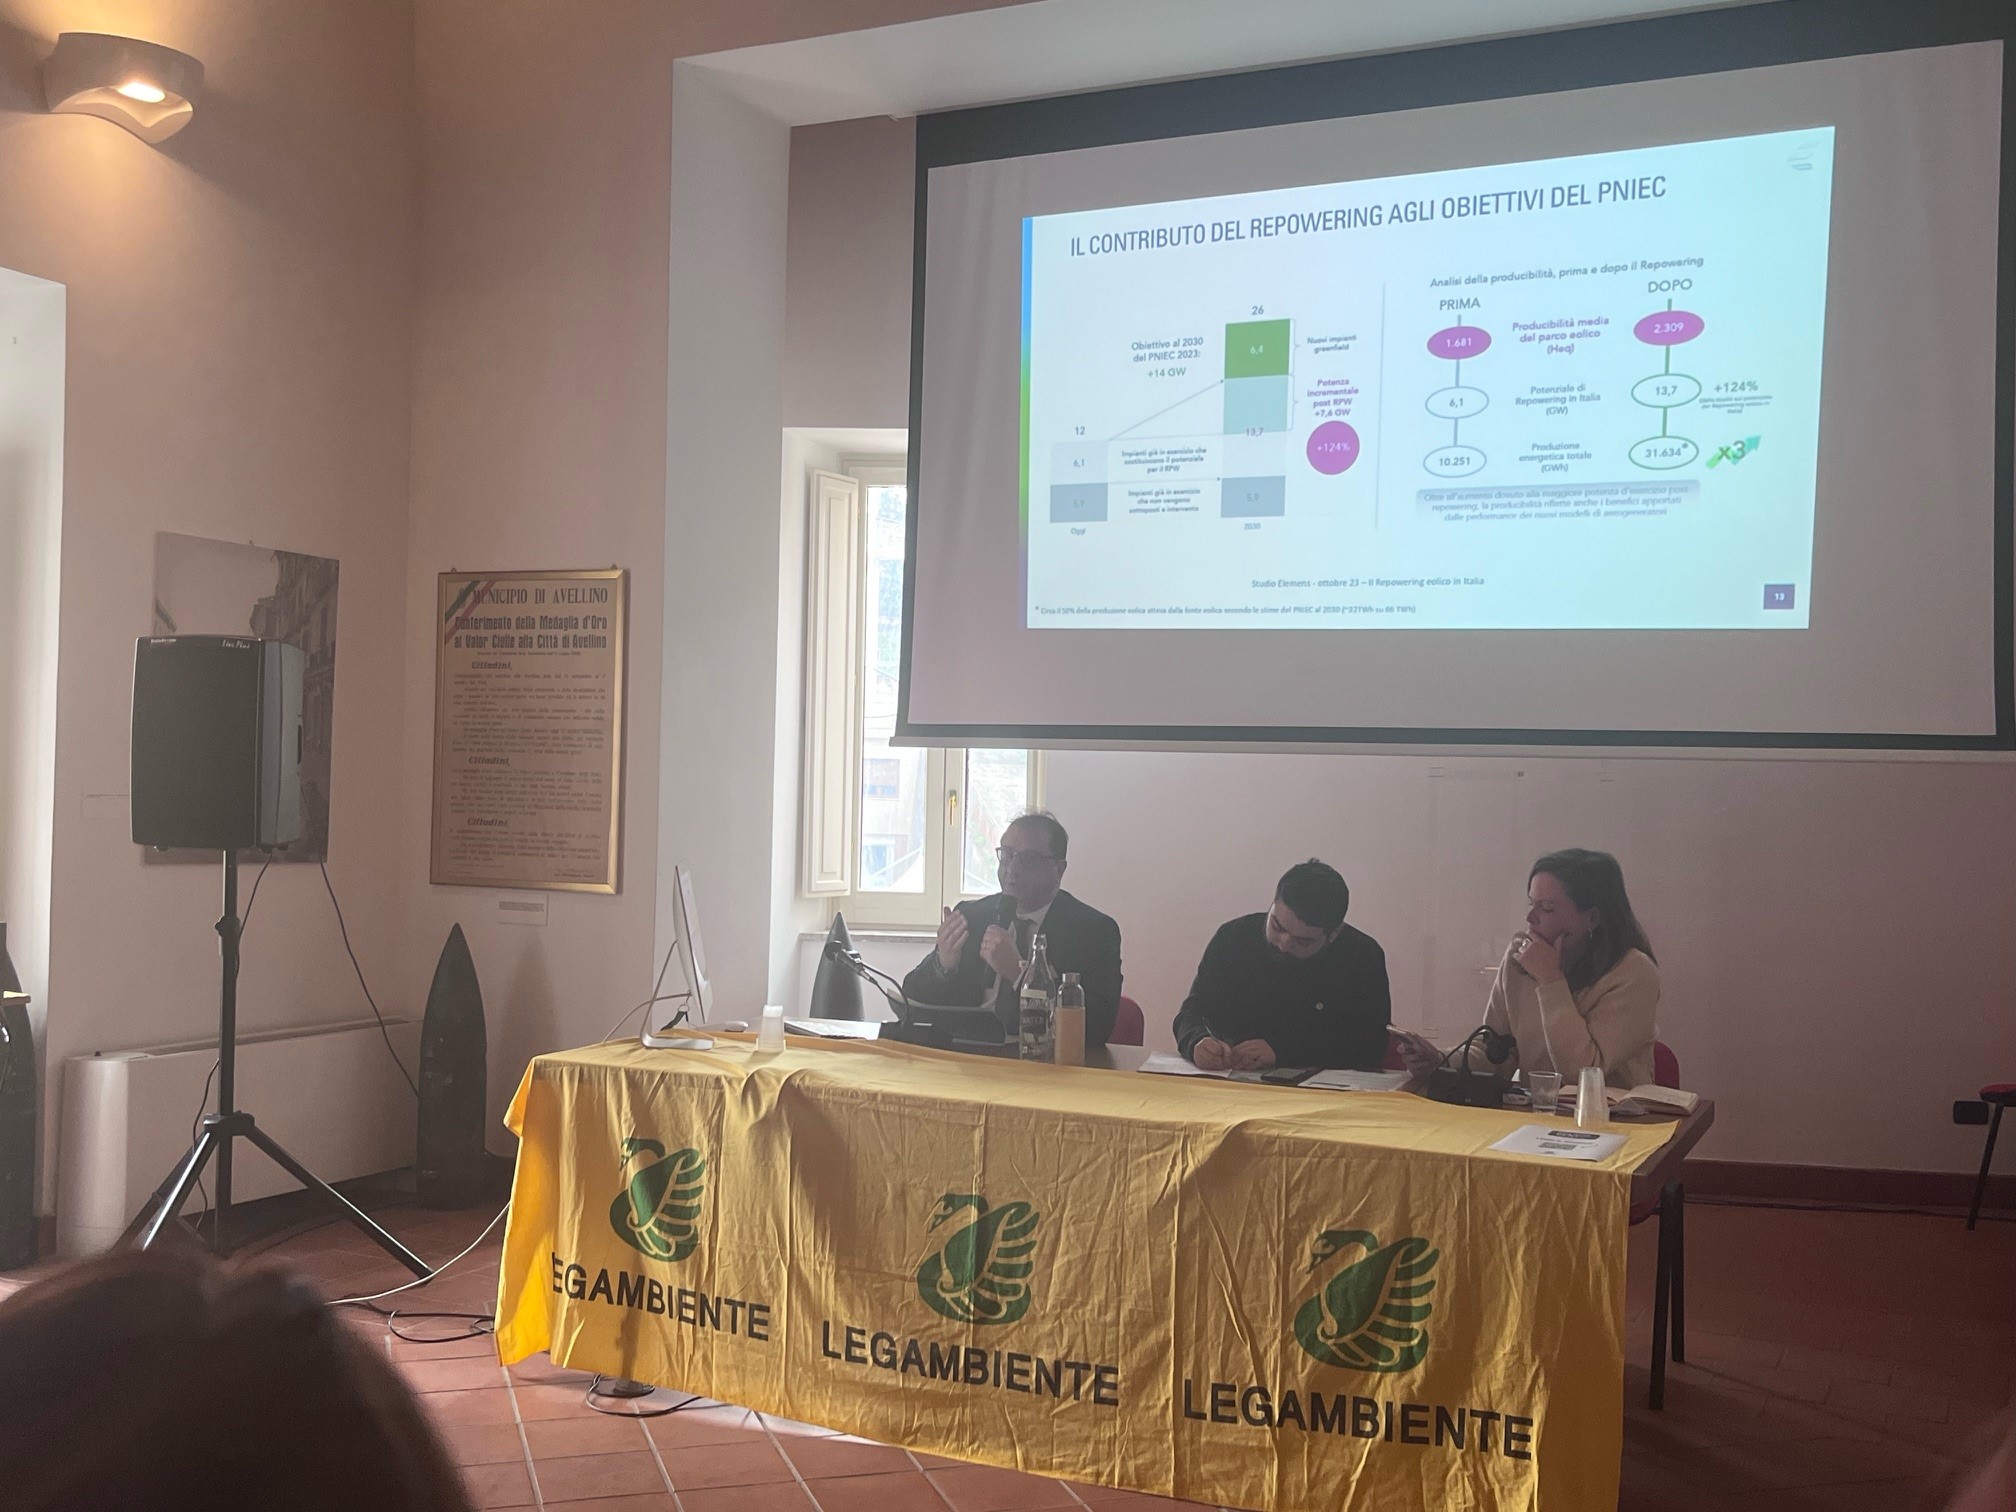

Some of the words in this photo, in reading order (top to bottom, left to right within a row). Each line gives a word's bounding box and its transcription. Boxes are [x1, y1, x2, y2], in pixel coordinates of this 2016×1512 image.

[1071, 237, 1086, 257] IL
[1089, 223, 1206, 255] CONTRIBUTO
[1211, 220, 1246, 243] DEL
[1250, 205, 1383, 239] REPOWERING
[1388, 199, 1435, 225] AGLI
[1441, 188, 1544, 220] OBIETTIVI
[1550, 184, 1592, 208] DEL
[1598, 175, 1667, 203] PNIEC
[1430, 276, 1462, 288] Analisi
[1464, 274, 1488, 285] della
[1558, 266, 1588, 280] prima
[1590, 266, 1597, 275] e
[1600, 261, 1628, 277] dopo
[1630, 261, 1638, 270] il
[1640, 256, 1704, 272] Repowering
[1648, 278, 1693, 293] DOPO
[1439, 297, 1481, 311] PRIMA
[1251, 305, 1265, 316] 26
[1512, 317, 1575, 332] Producibilità
[1578, 316, 1610, 327] media
[1653, 322, 1685, 334] 2.309
[1307, 337, 1327, 345] Nuovi
[1328, 335, 1357, 345] impianti
[1446, 337, 1472, 348] 1.681
[1519, 333, 1536, 343] del
[1538, 332, 1567, 345] parco
[1569, 329, 1601, 341] eolico
[1131, 338, 1171, 351] Obiettivo
[1172, 339, 1181, 348] al
[1182, 337, 1204, 347] 2030
[1314, 344, 1350, 355] greenfield
[1547, 343, 1575, 355] (Heq)
[1133, 353, 1147, 363] del
[1148, 351, 1175, 362] PNIEC
[1177, 349, 1201, 360] 2023:
[1250, 345, 1263, 356] 6,4
[1147, 368, 1166, 379] +14
[1168, 367, 1187, 378] GW
[1317, 379, 1350, 387] Potenza
[1530, 384, 1575, 395] Potenziale
[1577, 383, 1586, 393] di
[1714, 381, 1759, 393] +124%
[1307, 387, 1359, 398] incrementale
[1655, 385, 1678, 397] 13,7
[1313, 400, 1331, 409] post
[1332, 397, 1353, 407] RPW
[1449, 398, 1464, 409] 6,1
[1515, 394, 1567, 407] Repowering
[1569, 395, 1577, 403] in
[1579, 393, 1601, 403] Italia
[1314, 409, 1333, 419] +7,6
[1334, 408, 1352, 417] GW
[1545, 406, 1569, 416] (GW)
[1075, 427, 1086, 436] 12
[1246, 428, 1264, 438] 13,7
[1531, 443, 1580, 452] Produzione
[1717, 440, 1747, 461] x3
[1439, 457, 1471, 467] 10.251
[1518, 452, 1565, 464] energetica
[1566, 451, 1592, 461] totale
[1073, 459, 1085, 469] 6,1
[1541, 464, 1569, 474] (GWh)
[1071, 528, 1086, 536] Oggi
[1244, 523, 1261, 531] 2030
[1252, 579, 1276, 588] Studio
[1278, 579, 1311, 588] Elemens
[1317, 578, 1348, 587] ottobre
[1349, 578, 1360, 587] 23
[1375, 577, 1424, 588] Repowering
[1426, 576, 1451, 586] eolico
[1453, 577, 1461, 586] in
[1463, 576, 1485, 586] Italia
[473, 588, 528, 605] MUNICIPIO
[534, 588, 546, 604] DI
[552, 587, 608, 604] AVELLINO
[454, 616, 512, 630] Conferimento
[515, 615, 536, 630] della
[539, 615, 578, 632] Medaglia
[582, 615, 608, 630] d'Oro
[454, 634, 462, 649] al
[465, 634, 489, 649] Valor
[492, 634, 515, 649] Civile
[518, 634, 534, 649] alla
[537, 634, 559, 649] Città
[562, 634, 571, 649] di
[572, 634, 608, 649] Avellino
[551, 1252, 771, 1342] EGAMBIENTE
[822, 1320, 1120, 1407] LEGAMBIENTE
[1183, 1378, 1534, 1461] LEGAMBIENTE
